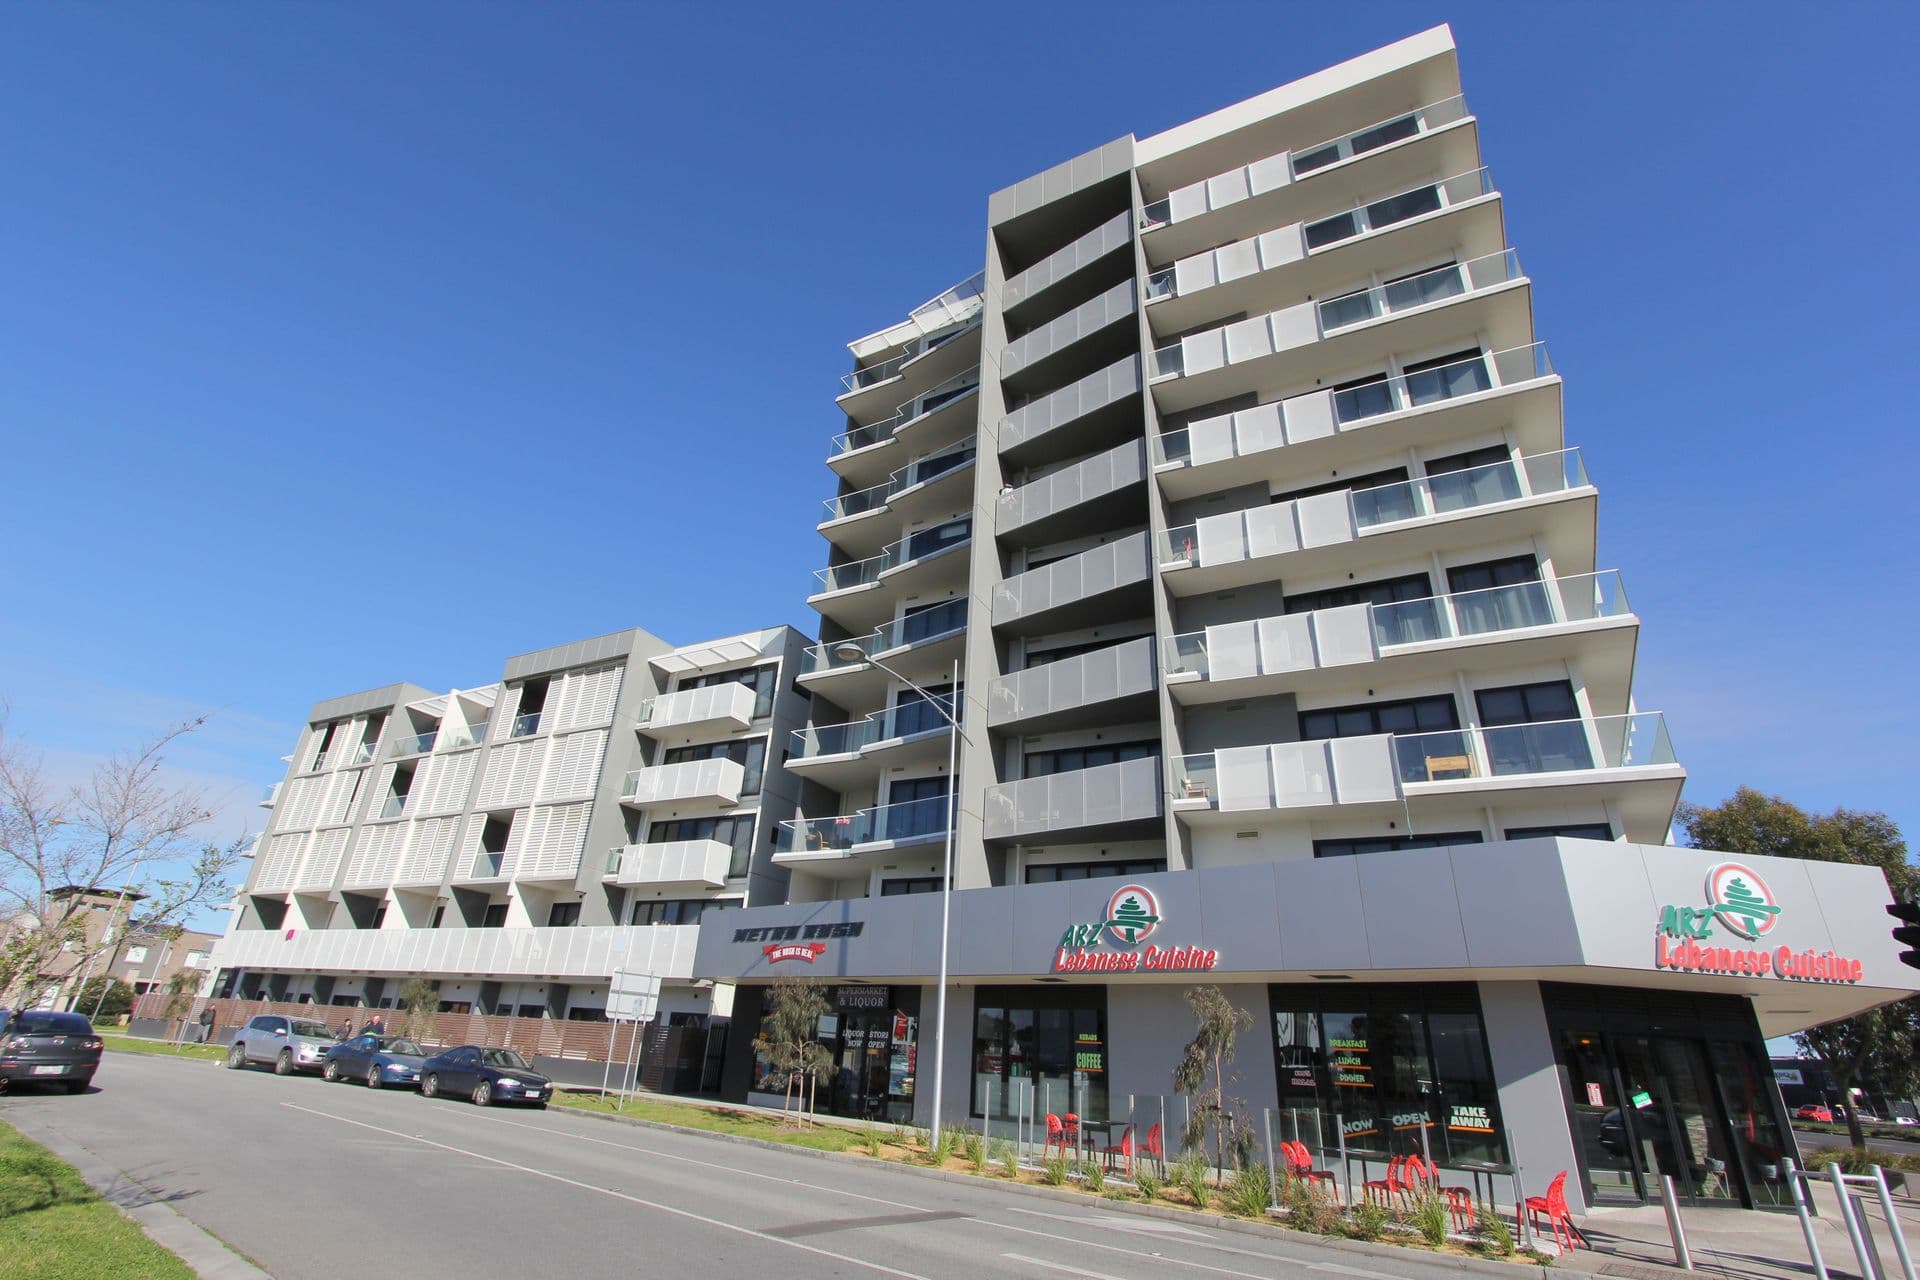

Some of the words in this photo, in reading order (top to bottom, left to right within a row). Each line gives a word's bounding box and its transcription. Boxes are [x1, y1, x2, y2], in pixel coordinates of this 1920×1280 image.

[1659, 904, 1716, 938] ARZ
[1062, 923, 1105, 947] ARZ
[1055, 947, 1140, 972] Lebanese
[1142, 944, 1218, 970] Cuisine
[1657, 935, 1771, 975] Lebanese
[1773, 944, 1864, 983] Cuisine
[840, 998, 845, 1006] &
[849, 998, 884, 1008] LIQUOR
[842, 1030, 865, 1039] LIQUOR
[1328, 1039, 1367, 1048] BREAKFAST
[1076, 1052, 1102, 1069] COFFEE
[1337, 1056, 1361, 1065] LUNCH
[1339, 1073, 1365, 1083] DINNER
[1451, 1105, 1487, 1118] TAKE
[1342, 1118, 1373, 1134] NOW
[1391, 1111, 1431, 1126] OPEN
[1450, 1116, 1490, 1129] AWAY
